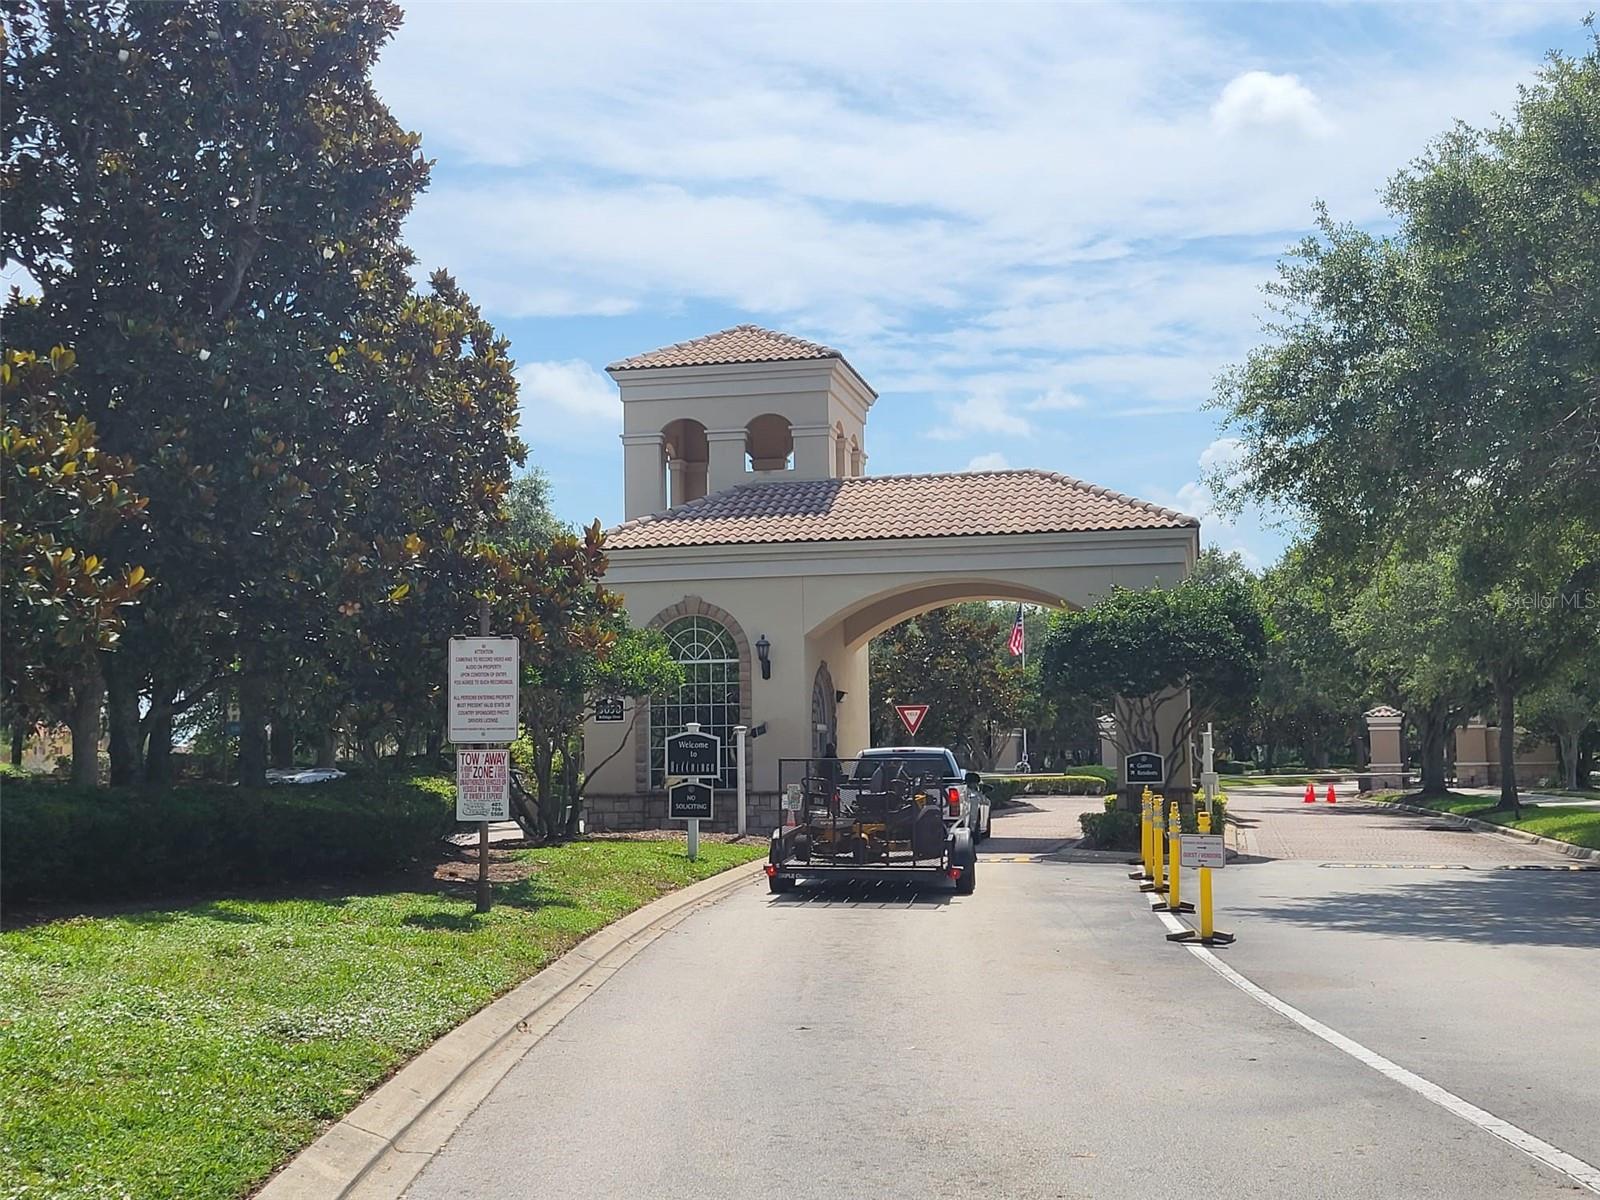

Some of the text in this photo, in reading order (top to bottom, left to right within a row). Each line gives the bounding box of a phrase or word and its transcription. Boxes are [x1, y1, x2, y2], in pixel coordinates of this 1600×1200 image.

[678, 740, 709, 748] Welcome
[460, 753, 506, 765] TOW AWAY
[473, 767, 493, 778] ZONE
